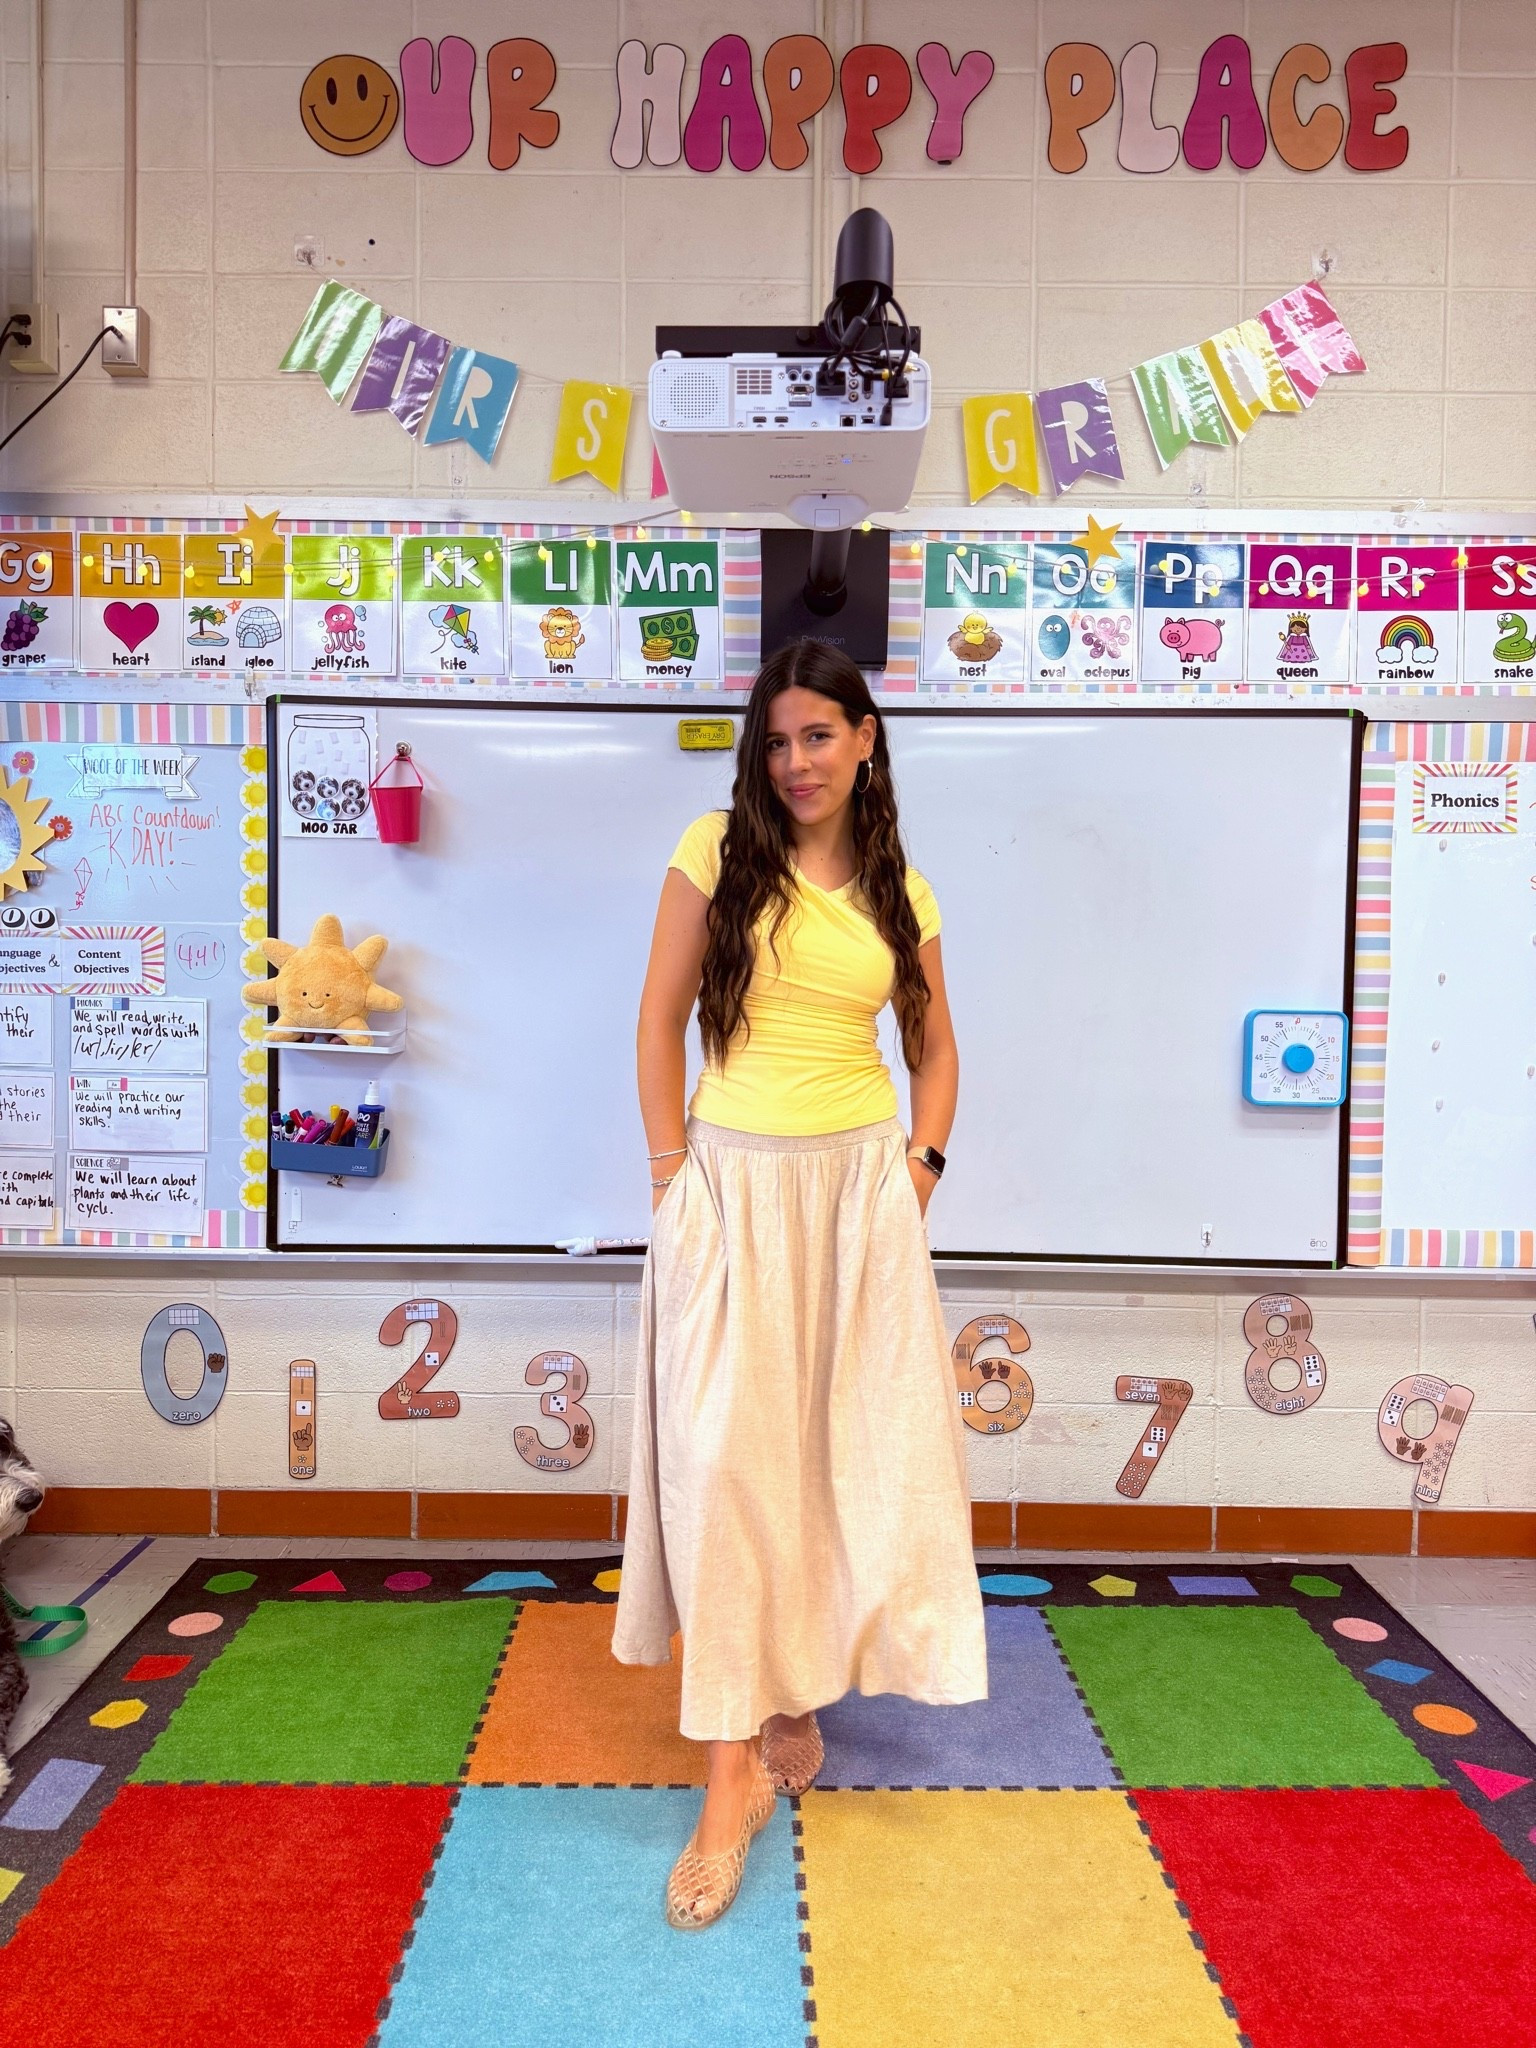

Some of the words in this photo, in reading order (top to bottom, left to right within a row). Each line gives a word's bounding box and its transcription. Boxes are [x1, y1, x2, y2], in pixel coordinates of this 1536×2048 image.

[610, 34, 994, 173] HAPPY
[1044, 34, 1410, 173] PLACE
[0, 541, 53, 593] Gg
[102, 542, 162, 585] Hh
[216, 542, 253, 586] Ii
[325, 545, 361, 596] Jj
[423, 545, 483, 588] Kk
[544, 549, 578, 591] Ll
[624, 550, 713, 593] Mm
[945, 553, 1008, 595] Nn
[1052, 553, 1117, 595] Oo
[1163, 552, 1223, 605] Pp
[1380, 556, 1436, 598] Rr
[1491, 555, 1536, 599] Ss
[1267, 554, 1334, 605] Qq
[2, 653, 46, 667] grapes
[112, 652, 150, 666] heart
[191, 653, 226, 667] island
[244, 655, 274, 670] igloo
[311, 654, 370, 670] jellyfish
[440, 657, 467, 671] kite
[549, 661, 574, 675] lion
[646, 663, 692, 678] money
[959, 664, 987, 678] nest
[1040, 666, 1066, 678] oval
[1084, 665, 1131, 679] octopus
[1182, 666, 1201, 680] pig
[1276, 667, 1319, 680] queen
[1378, 666, 1435, 680] rainbow
[1494, 665, 1535, 679] snake
[116, 758, 129, 775] OF
[131, 758, 150, 775] THE
[153, 759, 182, 776] WEEK
[1430, 793, 1500, 808] Phonics
[90, 803, 124, 828] ABC
[301, 822, 329, 834] MOO
[333, 822, 358, 834] JAR
[0, 950, 42, 959] nguage
[78, 949, 121, 959] Content
[0, 964, 46, 975] bjectives
[73, 964, 130, 976] Objectives
[0, 1005, 29, 1030] ntify
[74, 1010, 90, 1022] We
[96, 1011, 117, 1022] will
[6, 1022, 35, 1038] their
[73, 1024, 93, 1033] and
[131, 1022, 169, 1037] words
[171, 1022, 199, 1039] with
[1326, 1073, 1335, 1081] 20
[7, 1084, 46, 1098] stories
[75, 1091, 90, 1101] We
[94, 1091, 113, 1102] will
[118, 1089, 161, 1105] practice
[165, 1092, 185, 1103] our
[1272, 1086, 1281, 1094] 35
[8, 1109, 42, 1122] their
[74, 1102, 112, 1119] reading
[118, 1103, 141, 1116] and
[143, 1104, 182, 1120] writing
[75, 1158, 104, 1168] SCIENCE
[75, 1170, 95, 1184] We
[100, 1171, 122, 1185] will
[127, 1172, 158, 1186] learn
[162, 1173, 197, 1186] about
[0, 1181, 18, 1193] ith
[74, 1186, 105, 1203] plants
[110, 1188, 128, 1201] and
[129, 1187, 161, 1202] their
[168, 1187, 191, 1202] life
[1125, 1390, 1161, 1402] seven
[1275, 1396, 1306, 1411] eight
[172, 1411, 202, 1420] zero
[407, 1406, 431, 1417] two
[988, 1421, 1005, 1433] six
[536, 1455, 571, 1468] three
[291, 1465, 314, 1475] one
[1415, 1483, 1440, 1499] nine
